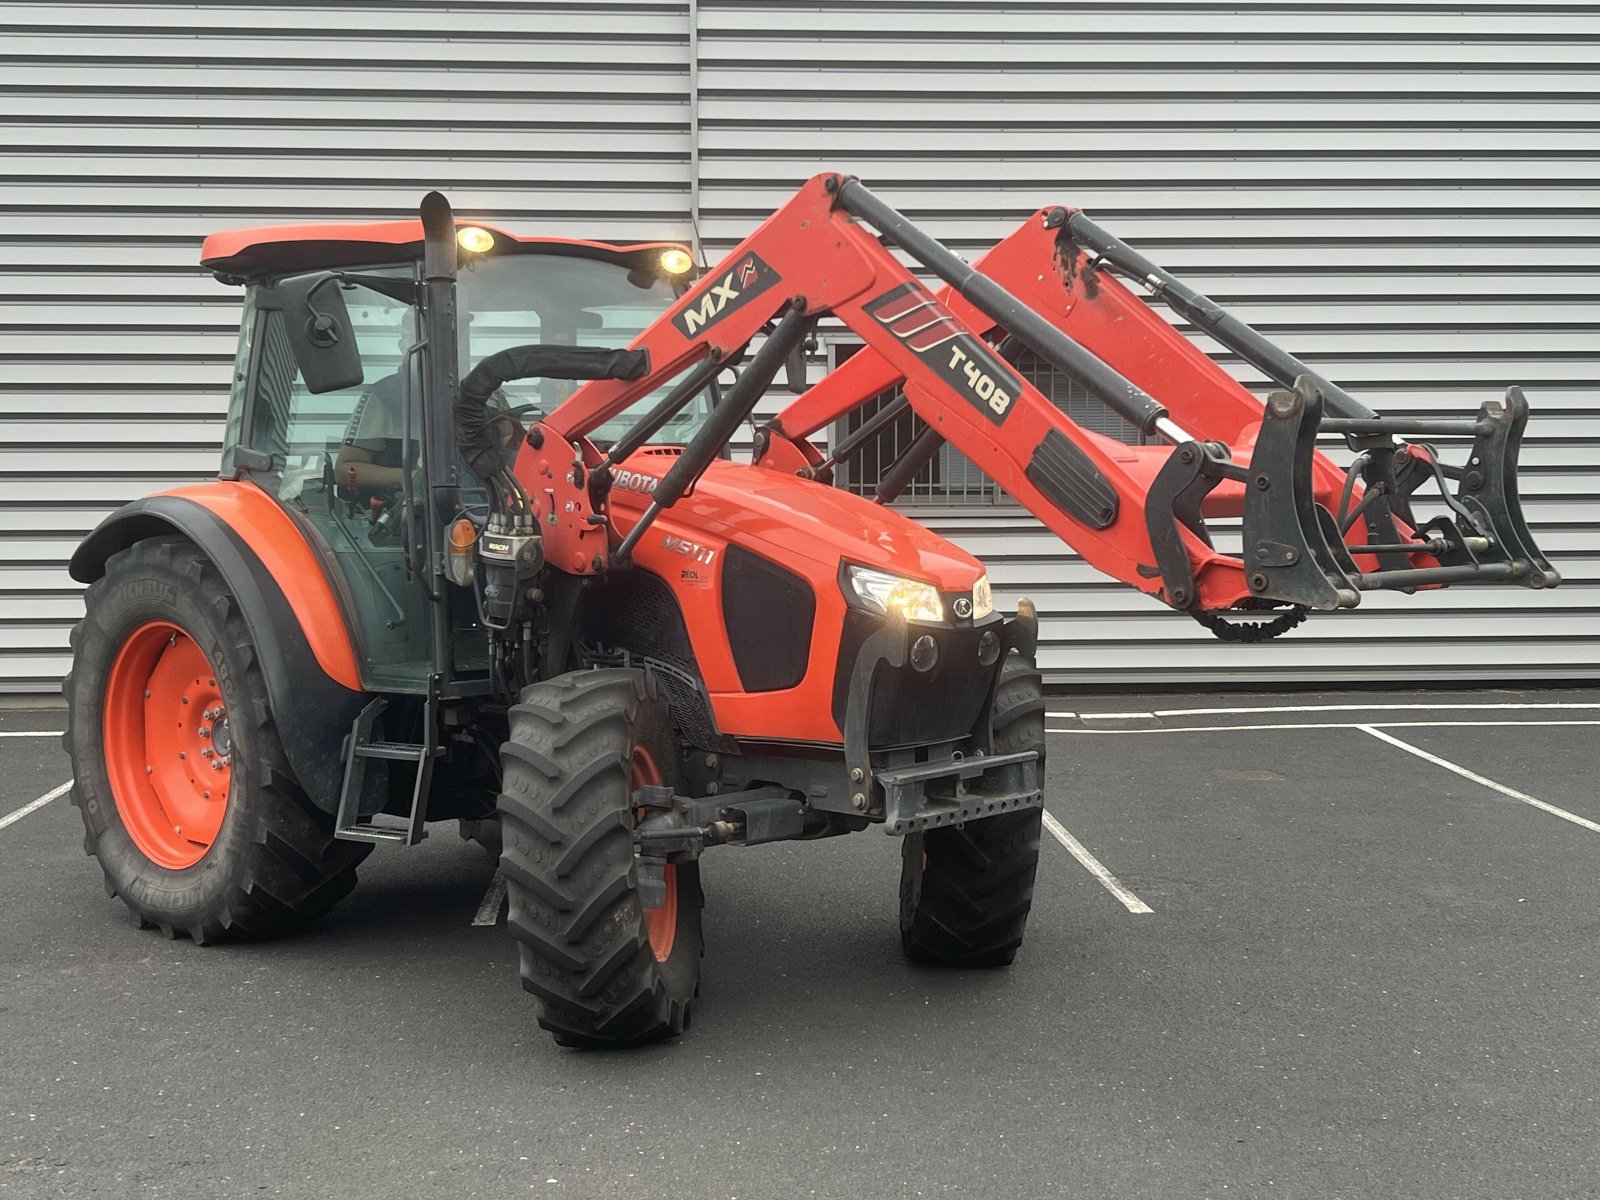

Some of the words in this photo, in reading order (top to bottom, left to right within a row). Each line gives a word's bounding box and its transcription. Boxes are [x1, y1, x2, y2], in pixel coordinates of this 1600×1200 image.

[683, 271, 740, 335] MX
[948, 344, 1011, 415] T408
[607, 467, 659, 494] UBOTA
[661, 535, 715, 566] M5111
